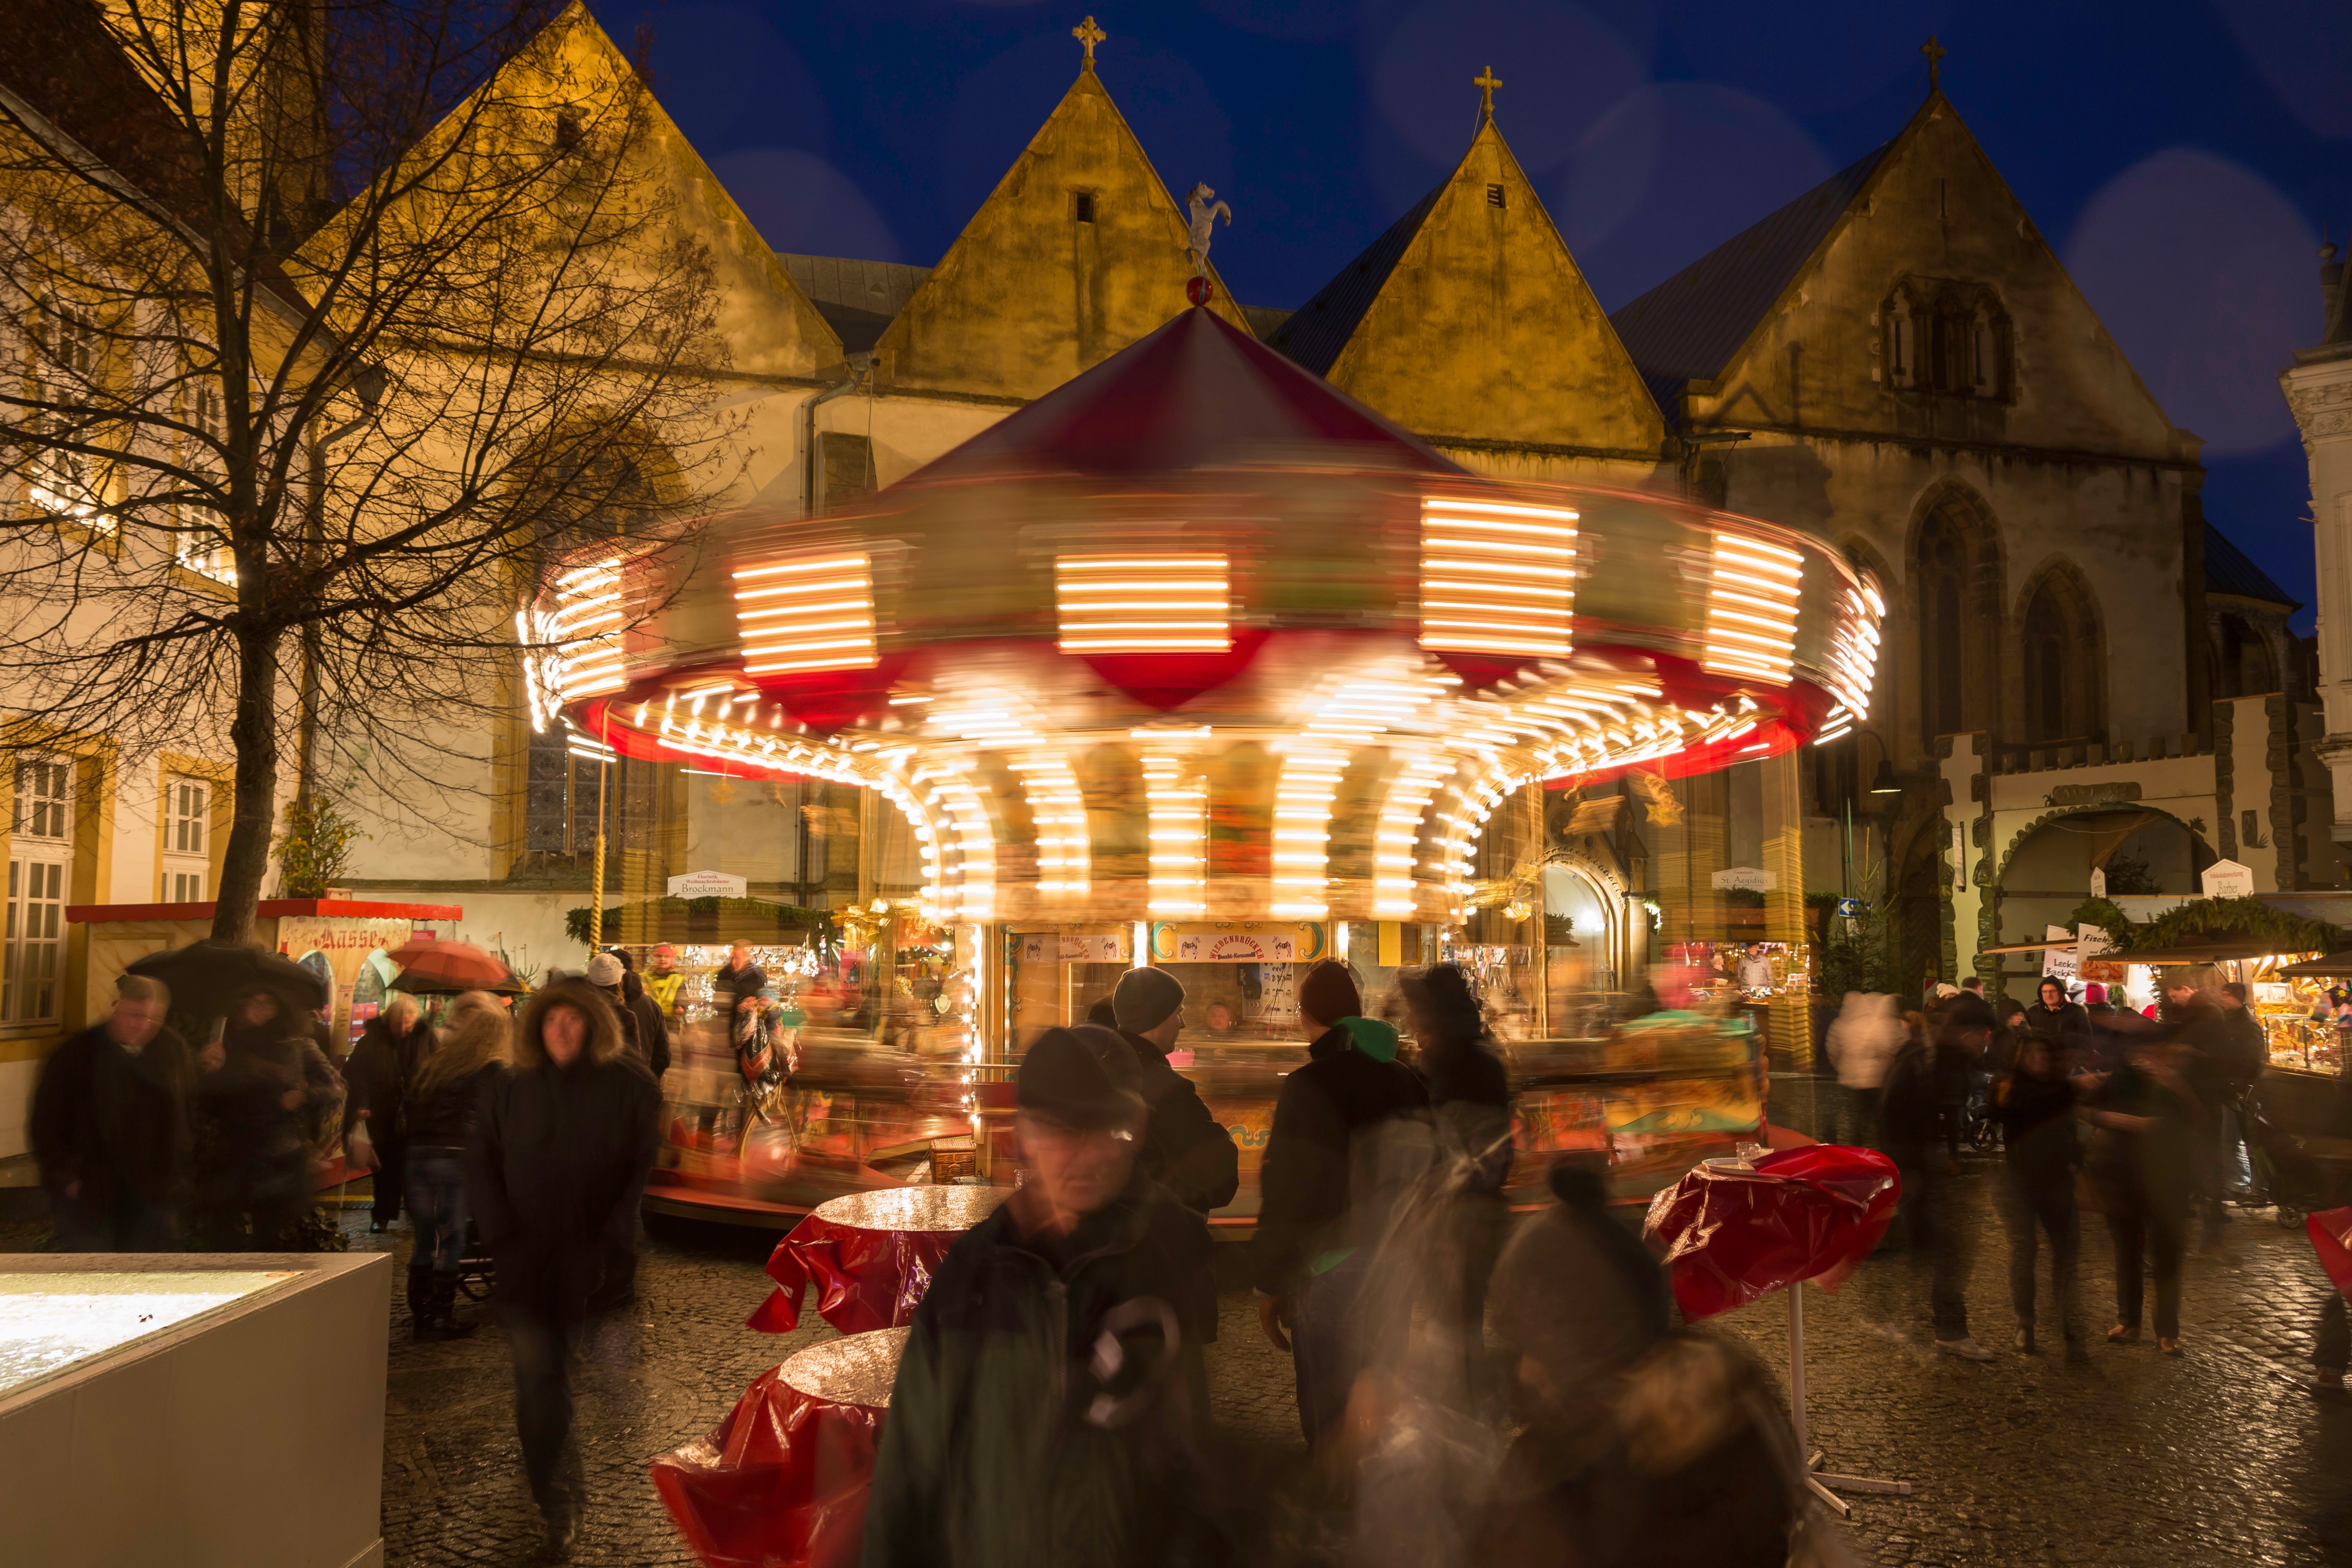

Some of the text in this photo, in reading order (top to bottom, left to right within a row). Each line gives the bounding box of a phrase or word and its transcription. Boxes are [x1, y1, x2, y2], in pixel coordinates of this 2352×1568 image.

[1735, 876, 1768, 885] Aegidius
[682, 884, 733, 893] Brockmann
[2218, 881, 2238, 894] Barber
[321, 929, 377, 949] Kasse
[2084, 934, 2108, 944] Fisch
[1209, 935, 1264, 960] WIEDENBRÜCKER
